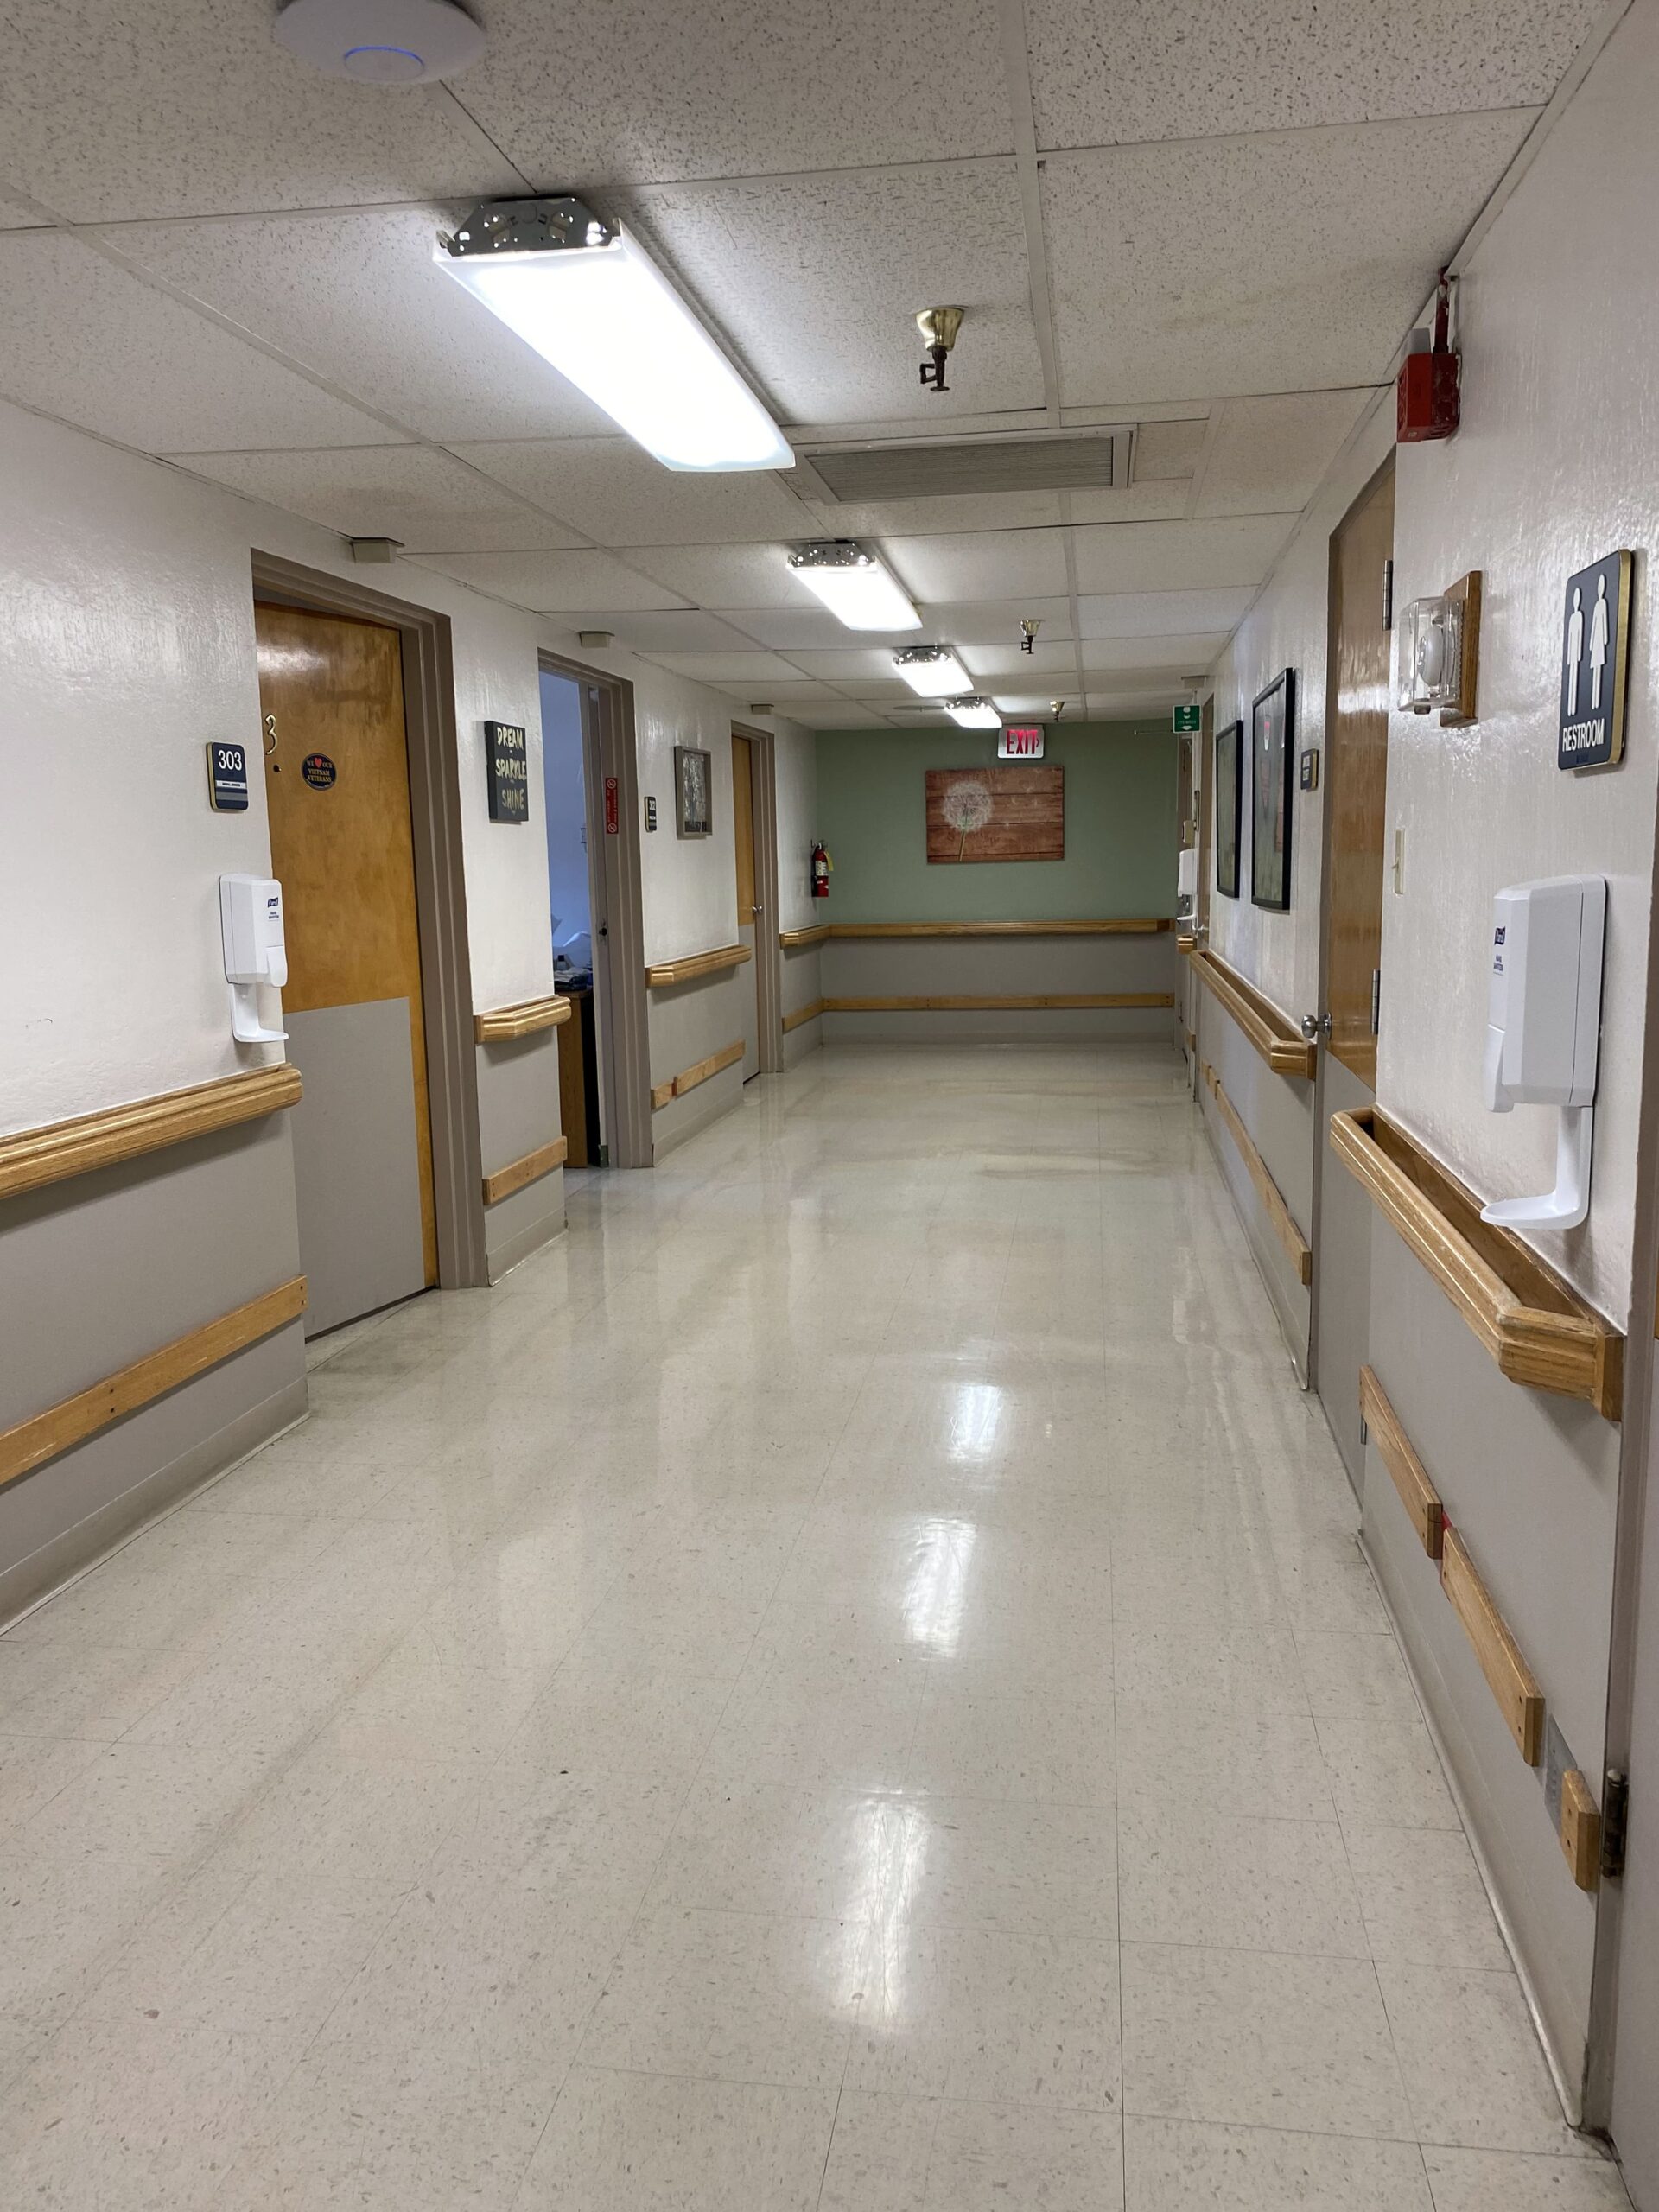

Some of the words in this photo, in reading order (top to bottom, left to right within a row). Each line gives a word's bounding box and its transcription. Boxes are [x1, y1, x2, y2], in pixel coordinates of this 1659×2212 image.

[497, 726, 524, 750] DREAM
[1007, 728, 1038, 754] EXIT
[1562, 718, 1605, 753] RESTROOM
[218, 749, 243, 771] 303
[495, 757, 527, 781] SPARKLE
[502, 788, 524, 810] SHINE
